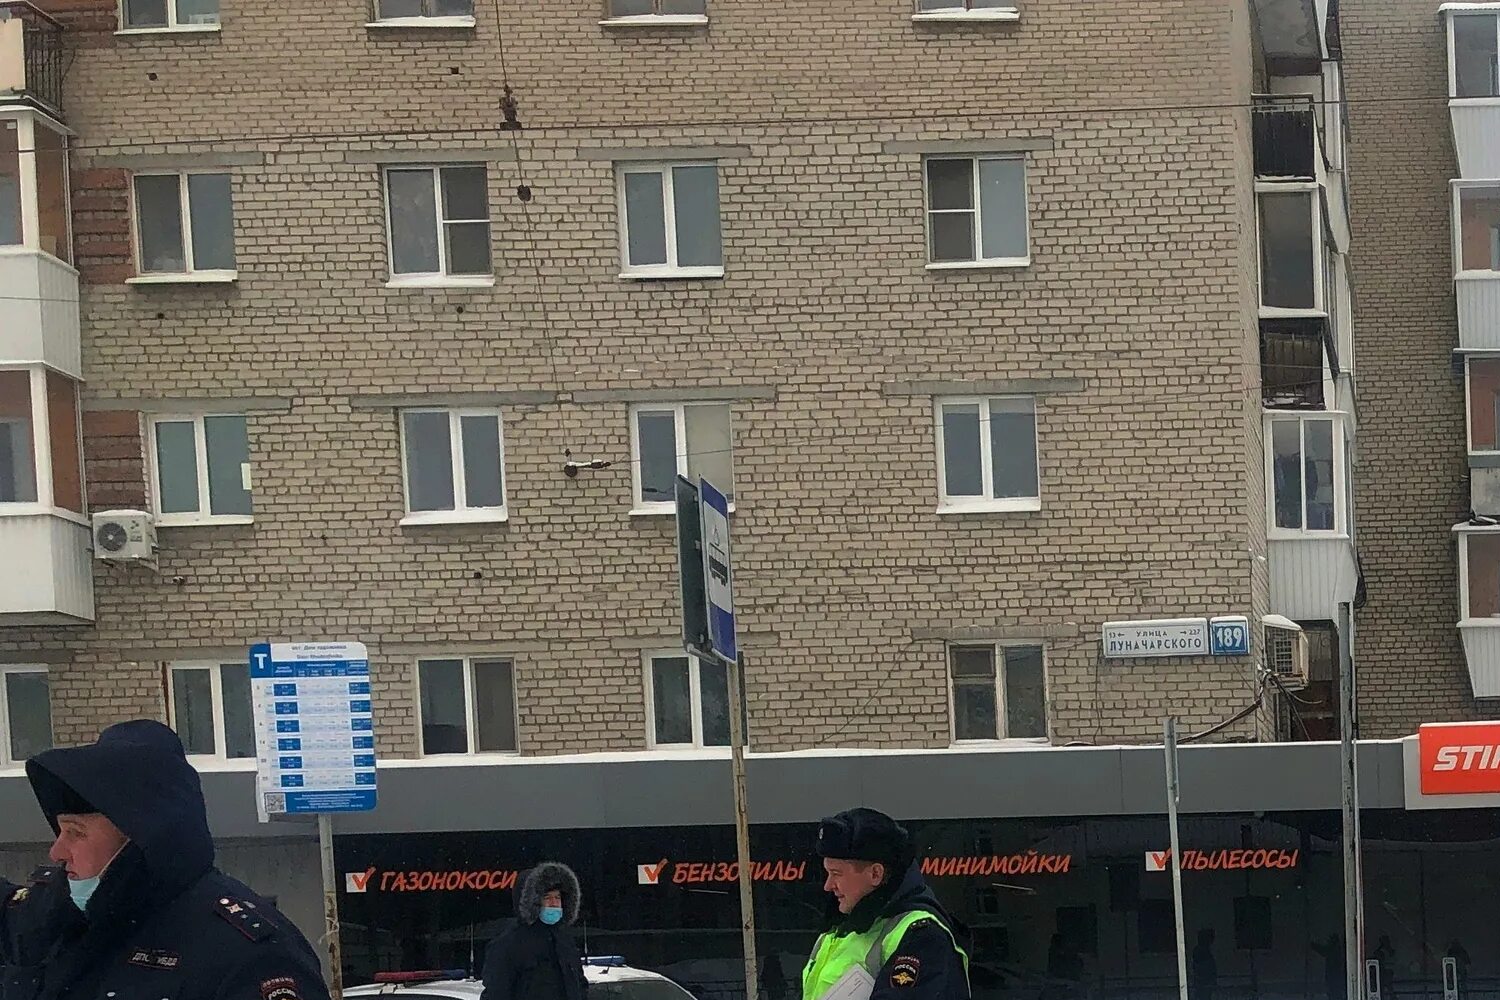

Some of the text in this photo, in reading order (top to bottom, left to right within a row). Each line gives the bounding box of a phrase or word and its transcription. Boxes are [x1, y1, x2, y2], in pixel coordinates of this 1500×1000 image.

[1136, 629, 1168, 638] УЛИЦА
[1216, 627, 1243, 648] 189
[1110, 638, 1202, 651] ЛУНАЧАРСКОГО
[920, 849, 1071, 876] МИНИМОЙКИ
[1181, 848, 1299, 870] ПЫЛЕСОСЫ
[379, 870, 518, 891] ГАЗОНОКОСИ
[268, 988, 297, 1000] РОССИЯ
